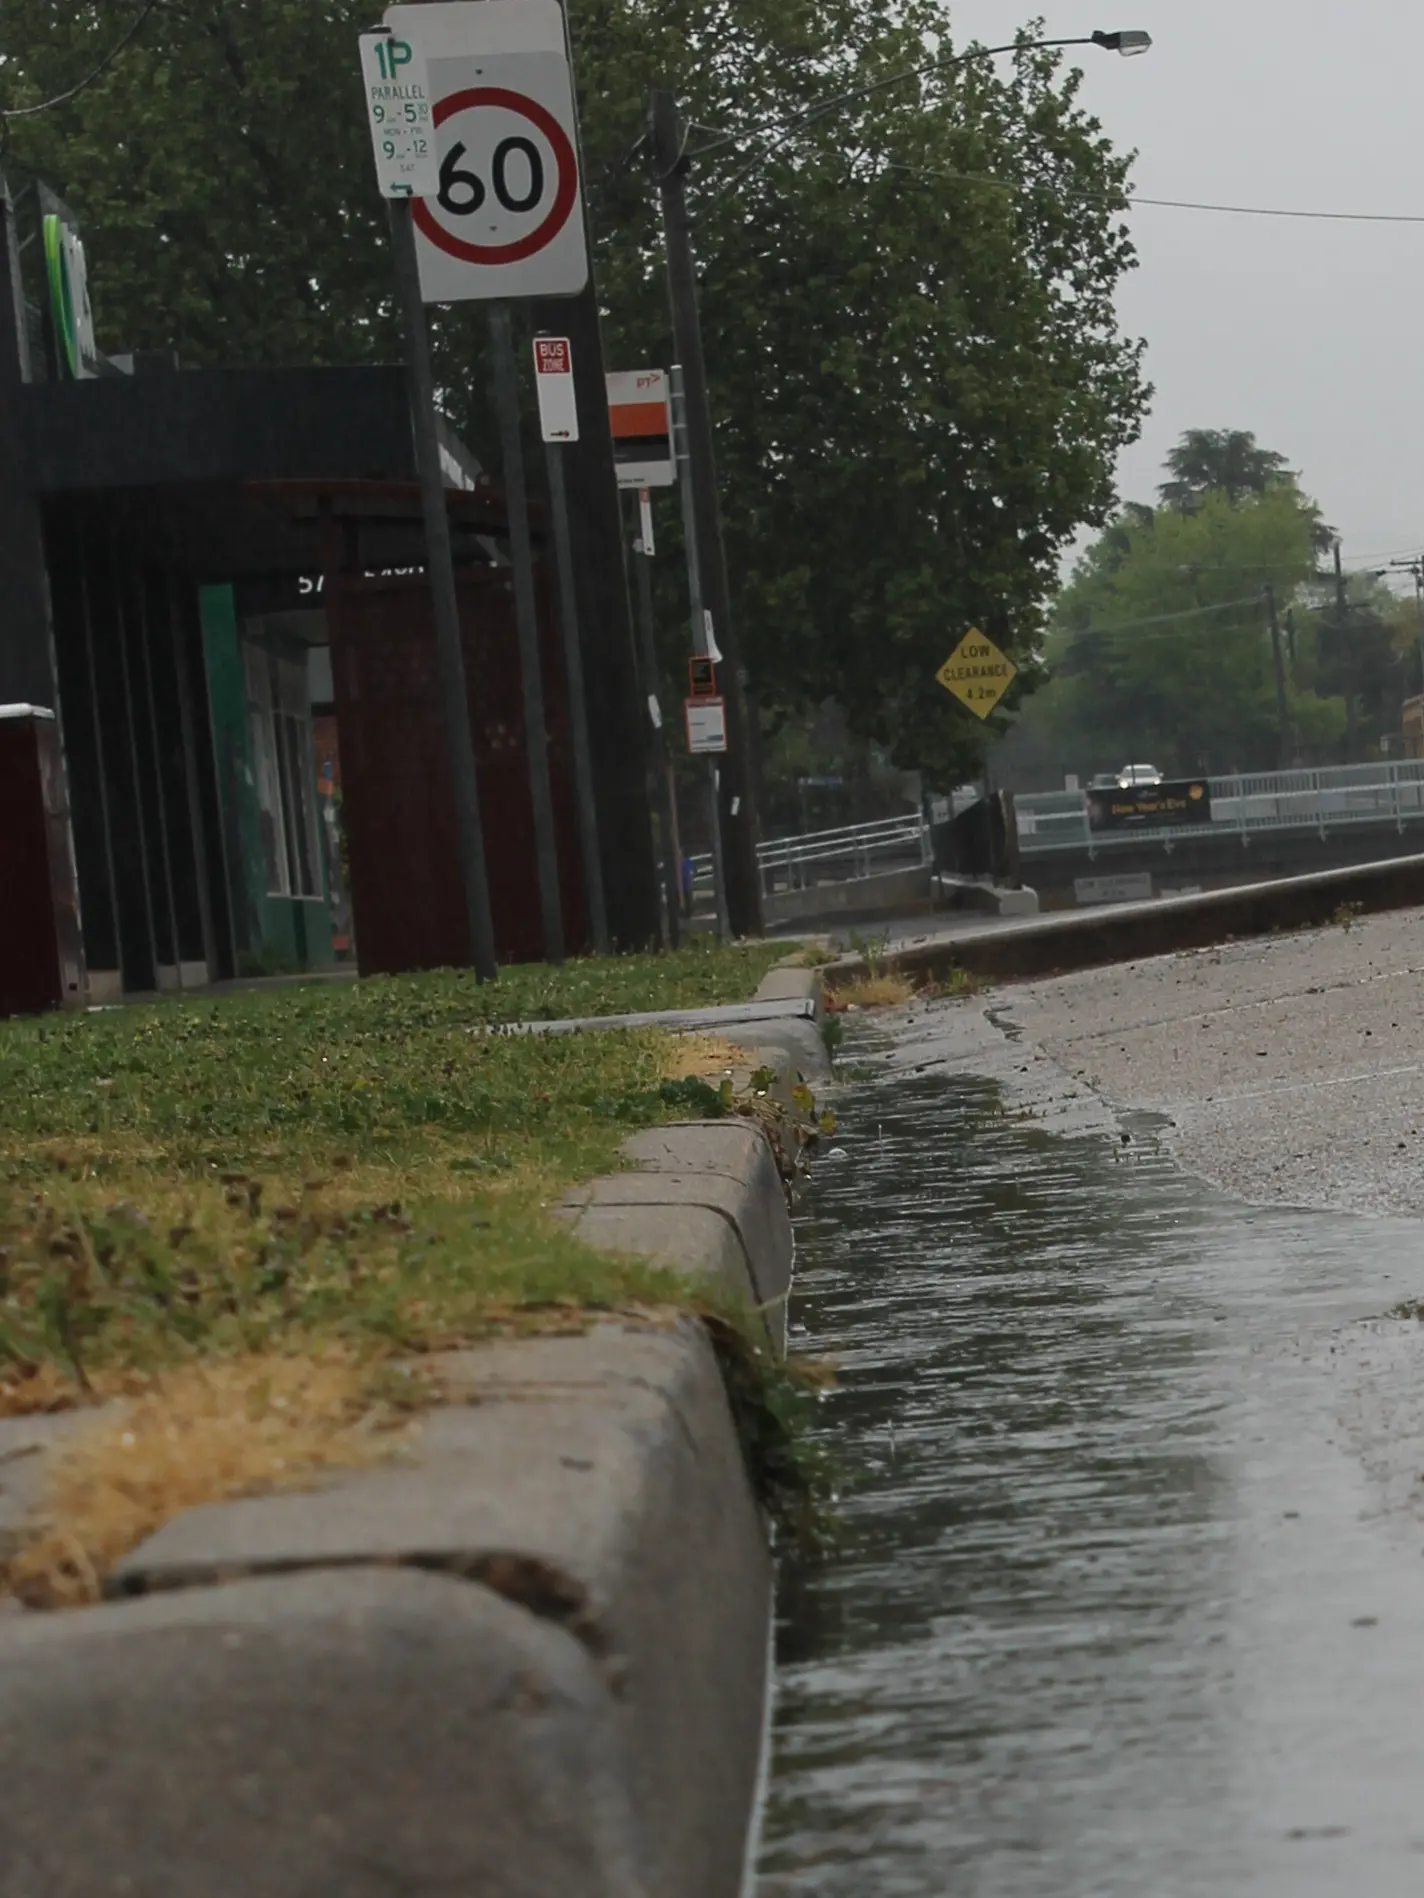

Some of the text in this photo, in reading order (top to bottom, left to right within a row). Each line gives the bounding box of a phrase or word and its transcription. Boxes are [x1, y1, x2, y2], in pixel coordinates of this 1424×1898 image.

[373, 40, 413, 80] 1P
[371, 84, 425, 101] PARALLEL
[437, 135, 544, 216] 60
[539, 343, 565, 357] BUS
[542, 357, 565, 372] ZONE
[960, 645, 990, 659] LOW
[943, 664, 1008, 681] CLEARANCE
